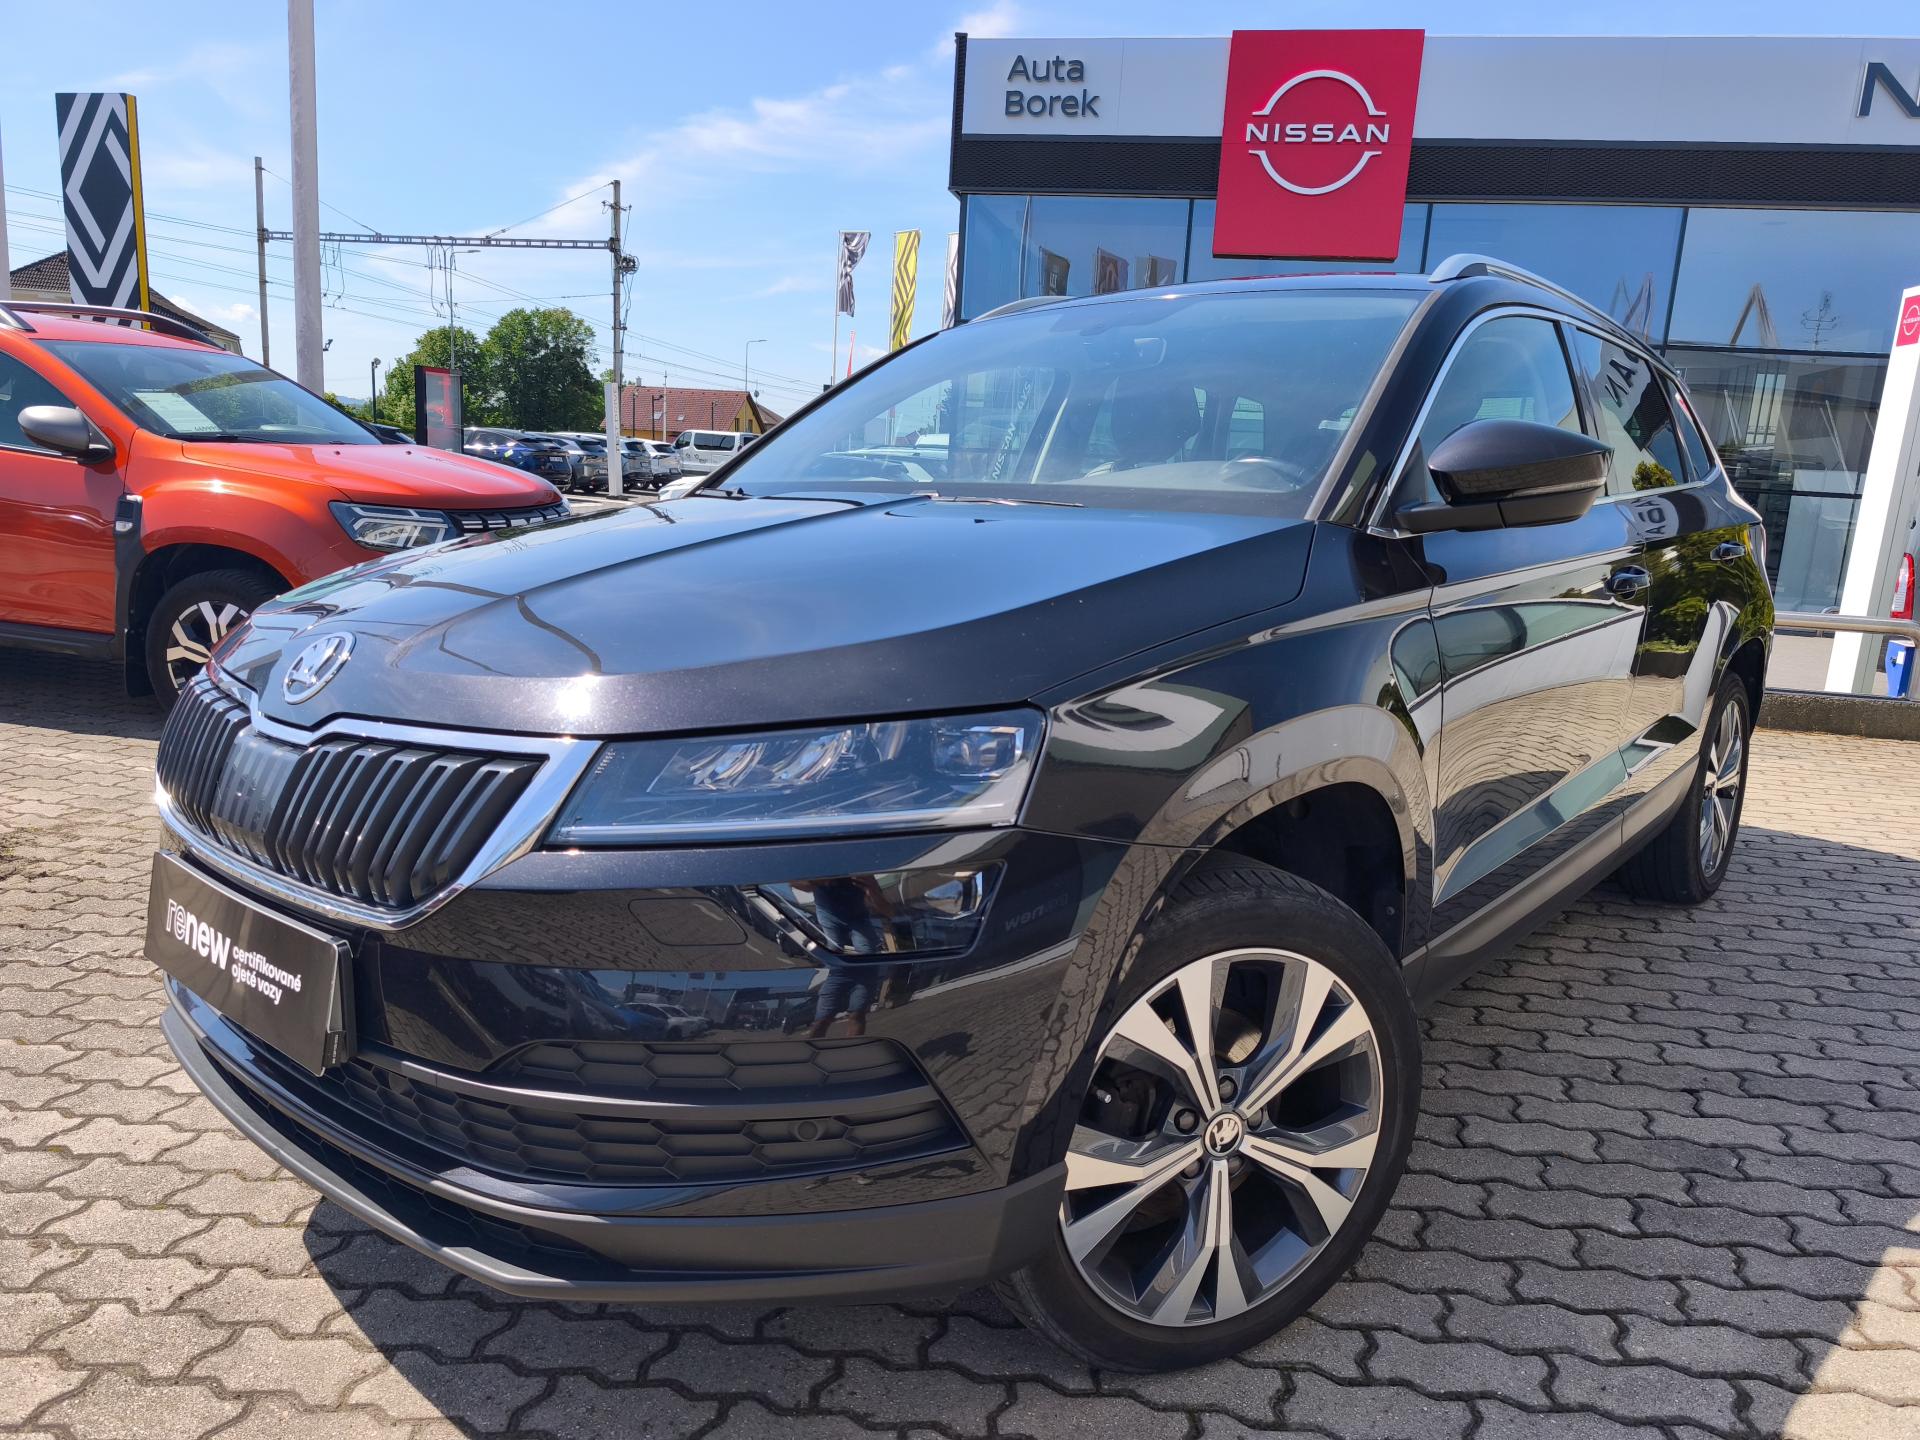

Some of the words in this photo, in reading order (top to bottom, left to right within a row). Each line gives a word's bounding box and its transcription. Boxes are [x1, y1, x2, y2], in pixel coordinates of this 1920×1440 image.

[1007, 54, 1085, 82] Auta
[1005, 88, 1100, 117] Borek
[1246, 123, 1390, 143] NISSAN
[166, 898, 231, 970] renew
[231, 963, 256, 988] ojeté
[257, 977, 282, 1005] vozy
[232, 945, 302, 992] certifikované
